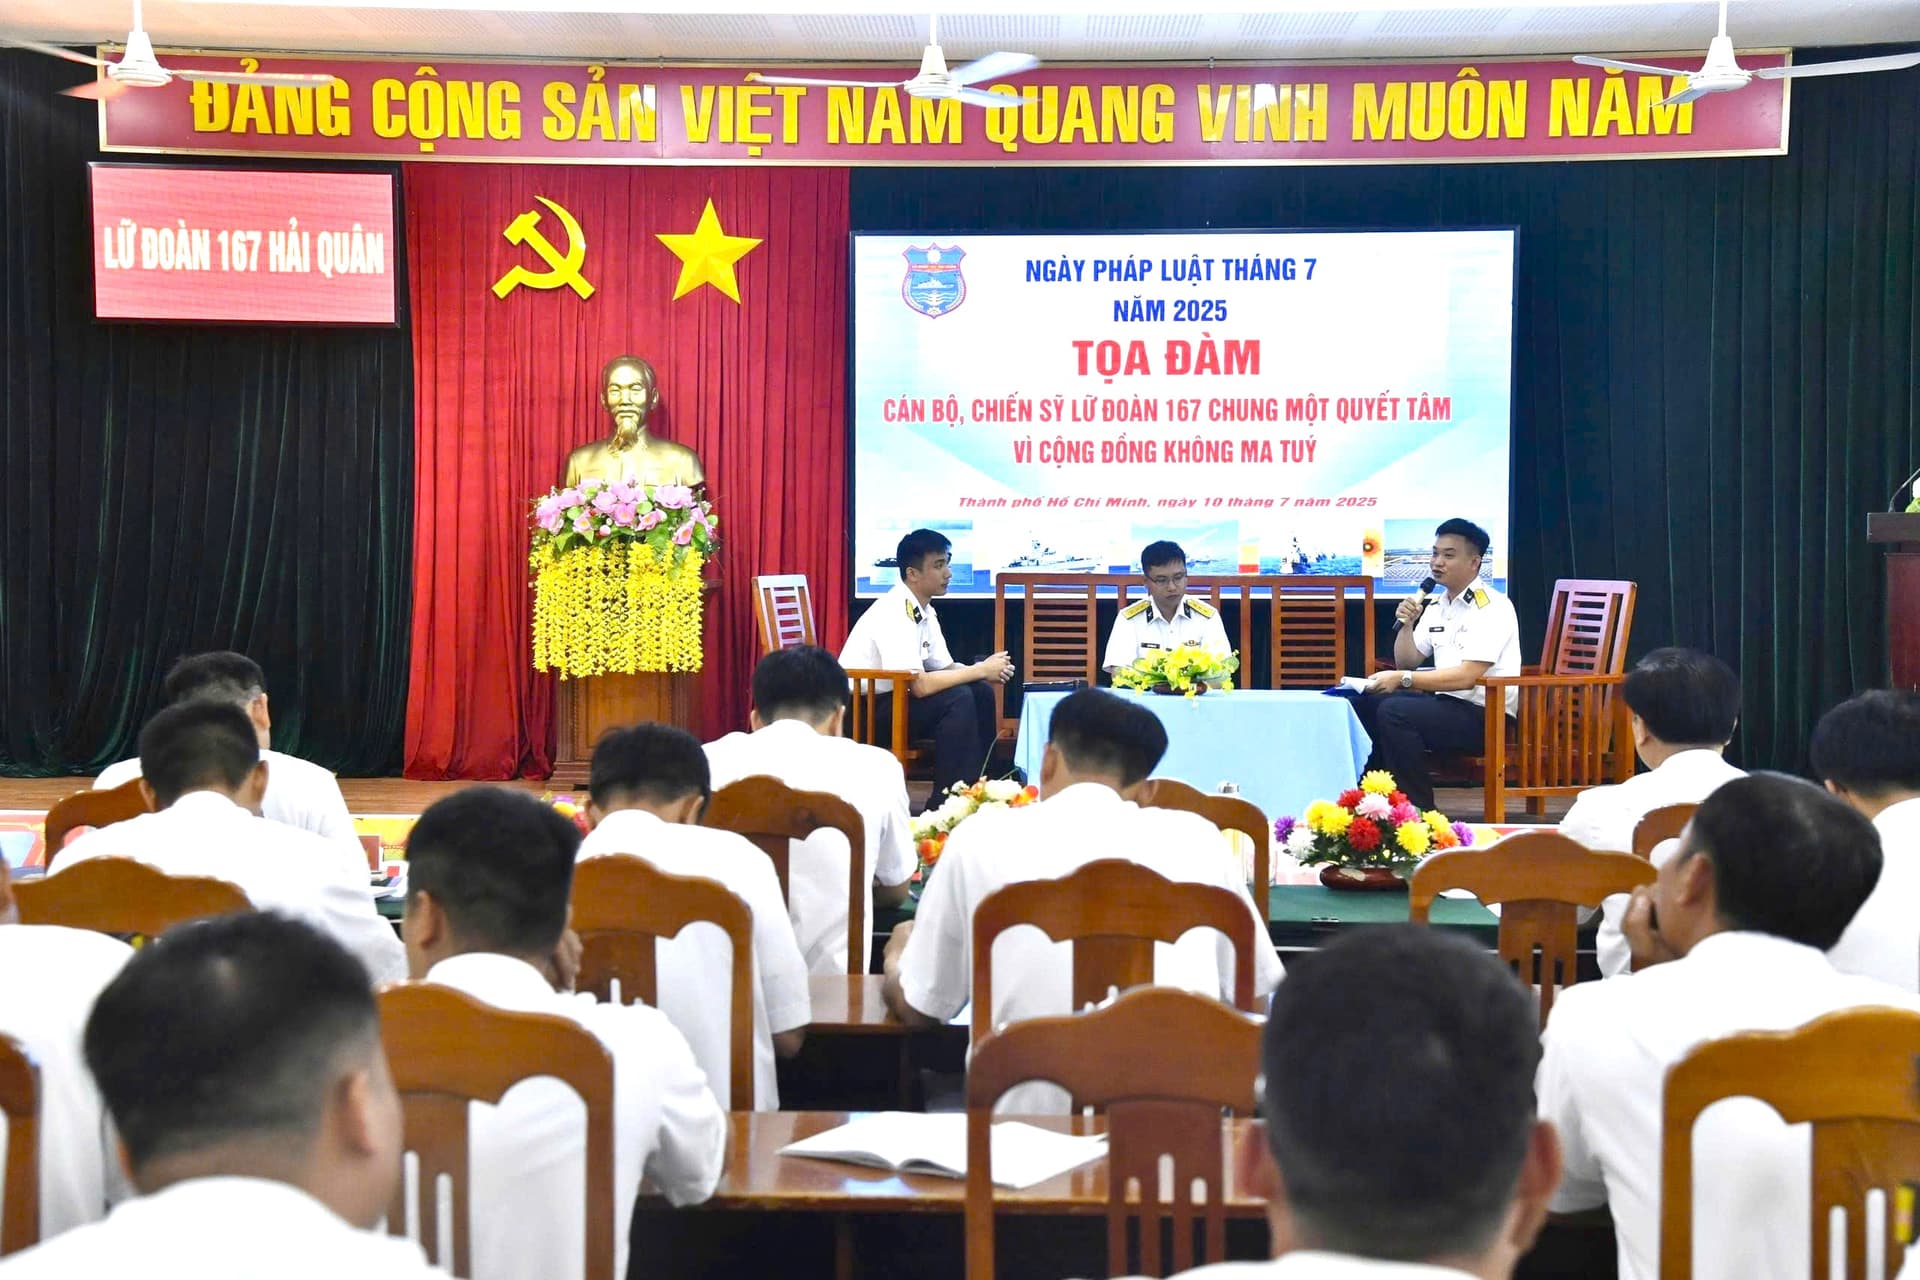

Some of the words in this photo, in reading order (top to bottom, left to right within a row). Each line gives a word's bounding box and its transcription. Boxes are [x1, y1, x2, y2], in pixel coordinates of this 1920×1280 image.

[189, 57, 351, 137] ĐẢNG
[372, 65, 521, 152] CỘNG
[542, 64, 657, 142] SẢN
[680, 72, 808, 156] VIỆT
[827, 84, 963, 145] NAM
[985, 83, 1176, 152] QUANG
[1196, 83, 1328, 143] VINH
[1352, 67, 1527, 141] MUÔN
[1549, 65, 1695, 137] NĂM
[104, 217, 137, 270] LỮ
[141, 219, 211, 271] ĐOÀN
[217, 229, 262, 272] 167
[269, 216, 311, 273] HẢI
[317, 223, 385, 279] QUÂN
[1025, 255, 1086, 283] NGÀY
[1093, 254, 1153, 282] PHÁP
[1161, 254, 1215, 287] LUẬT
[1222, 253, 1297, 281] THÁNG
[1303, 257, 1317, 280] 7
[1113, 295, 1166, 323] NĂM
[1173, 299, 1228, 323] 2025
[1071, 339, 1152, 385] TỌA
[1163, 331, 1261, 376] ĐÀM
[883, 394, 926, 423] CÁN
[931, 394, 965, 428] BỘ,
[971, 391, 1033, 423] CHIẾN
[1039, 394, 1065, 423] SỸ
[1071, 394, 1099, 423] LỮ
[1101, 394, 1159, 423] ĐOÀN
[1165, 399, 1202, 423] 167
[1208, 398, 1279, 423] CHUNG
[1285, 393, 1330, 427] MỘT
[1336, 390, 1401, 424] QUYẾT
[1406, 392, 1451, 421] TÂM
[1013, 434, 1033, 464] VÌ
[1039, 435, 1095, 469] CỘNG
[1100, 432, 1157, 464] ĐỒNG
[1163, 434, 1234, 464] KHÔNG
[1240, 439, 1274, 464] MA
[1279, 434, 1318, 464] TUÝ
[1203, 497, 1224, 508] 10
[1280, 497, 1290, 508] 7
[1293, 497, 1331, 508] năm
[1335, 496, 1378, 508] 2025
